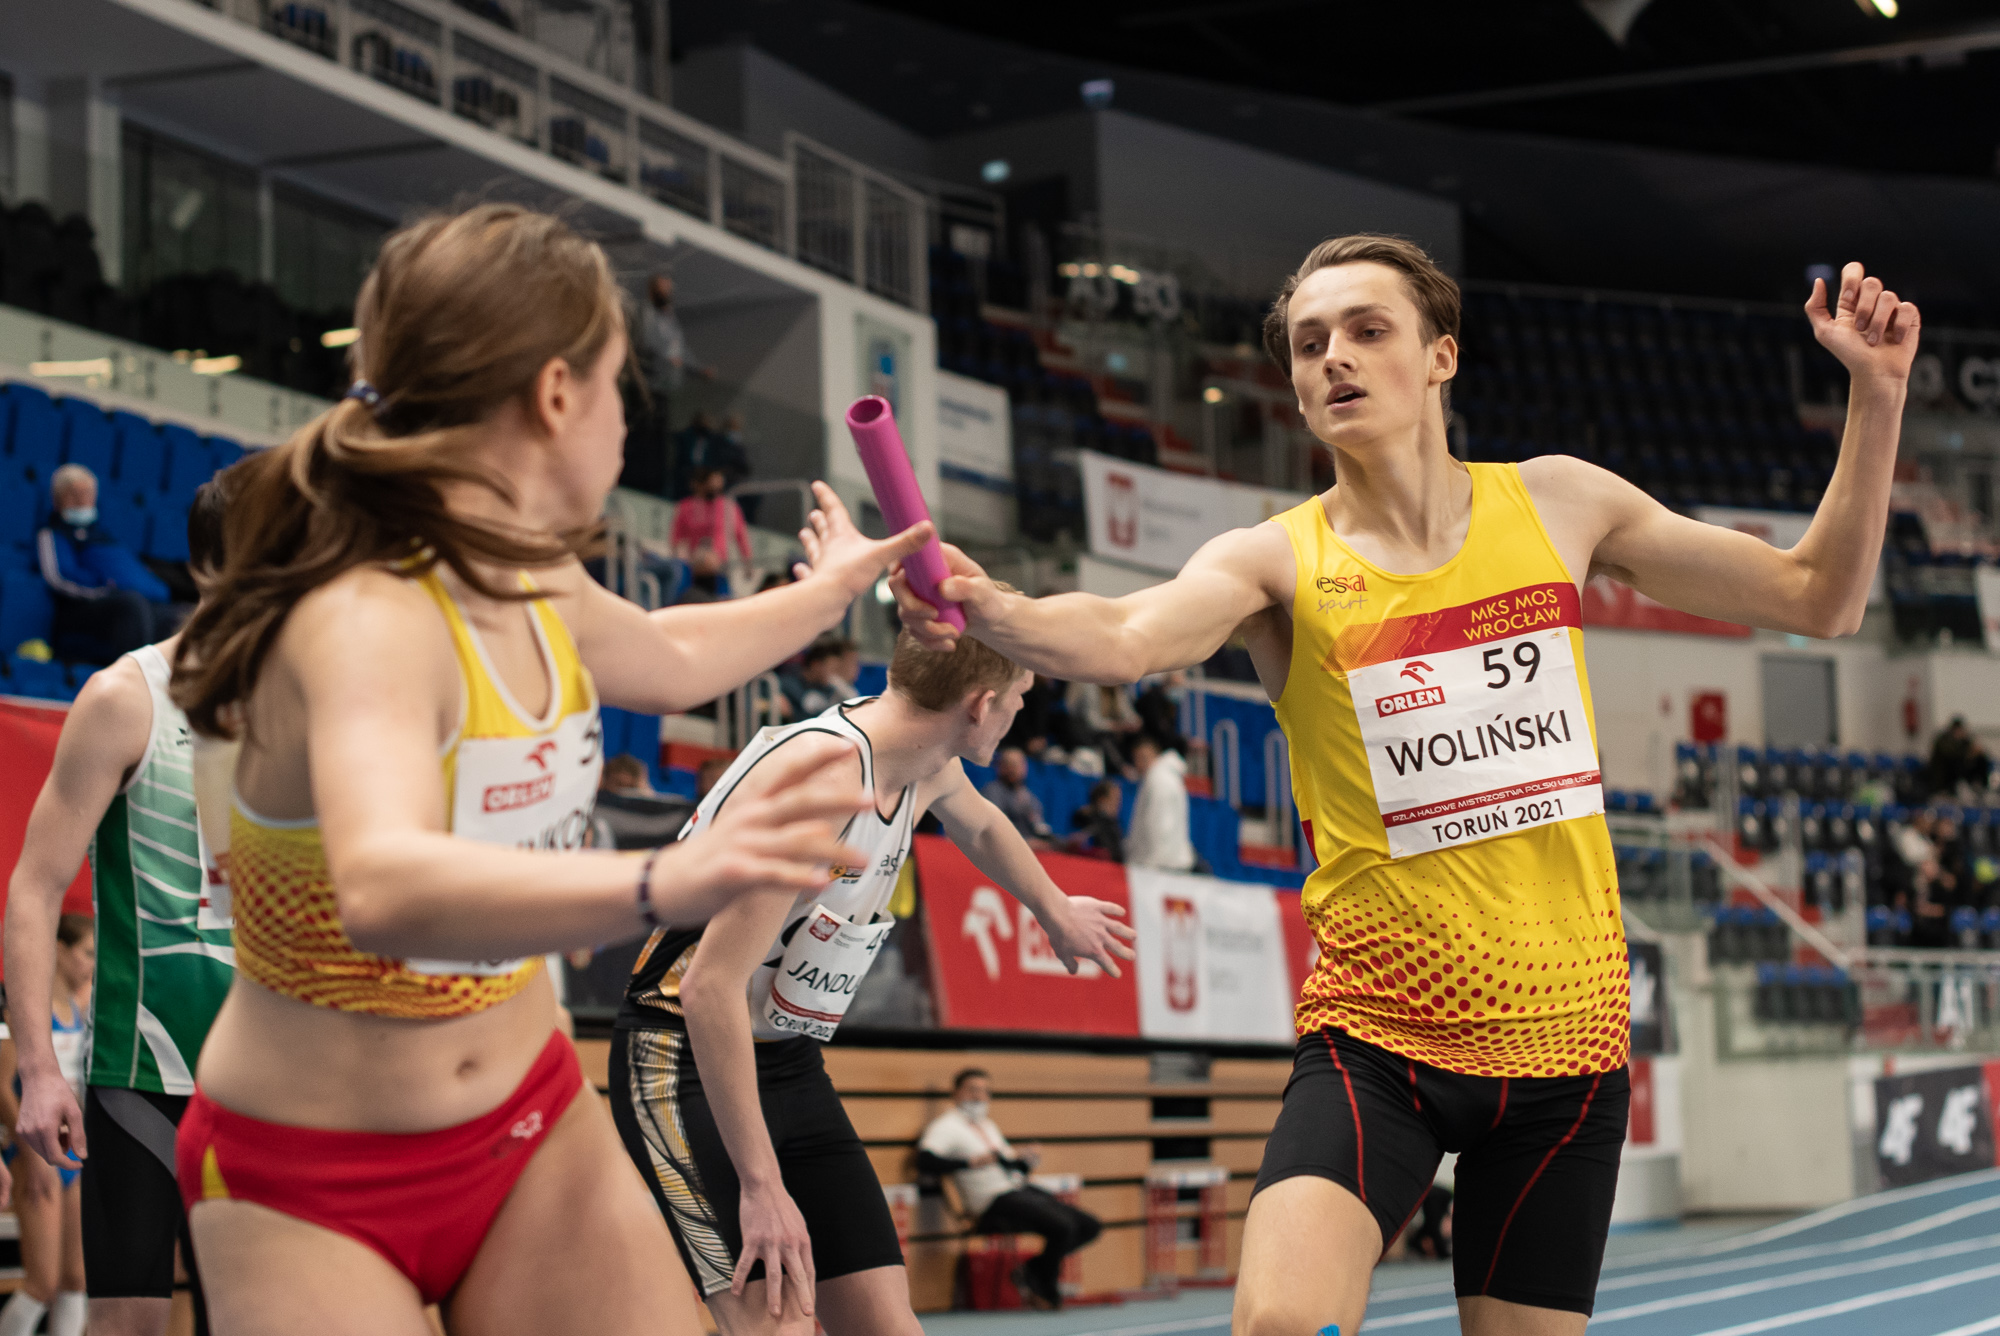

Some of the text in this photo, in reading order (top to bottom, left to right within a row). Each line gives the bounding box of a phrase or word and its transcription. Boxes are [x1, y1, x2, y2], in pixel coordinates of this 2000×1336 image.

[1463, 606, 1562, 641] WROCŁAW
[1470, 588, 1558, 624] MKS MOS
[1482, 641, 1542, 690] 59
[1380, 688, 1442, 714] ORLEN
[1384, 709, 1572, 777] WOLIŃSKI
[1392, 774, 1593, 823] PZLA HALOWE MISTRZOSTWA POLSKI U18 U20
[1432, 798, 1565, 843] TORUŃ 2021
